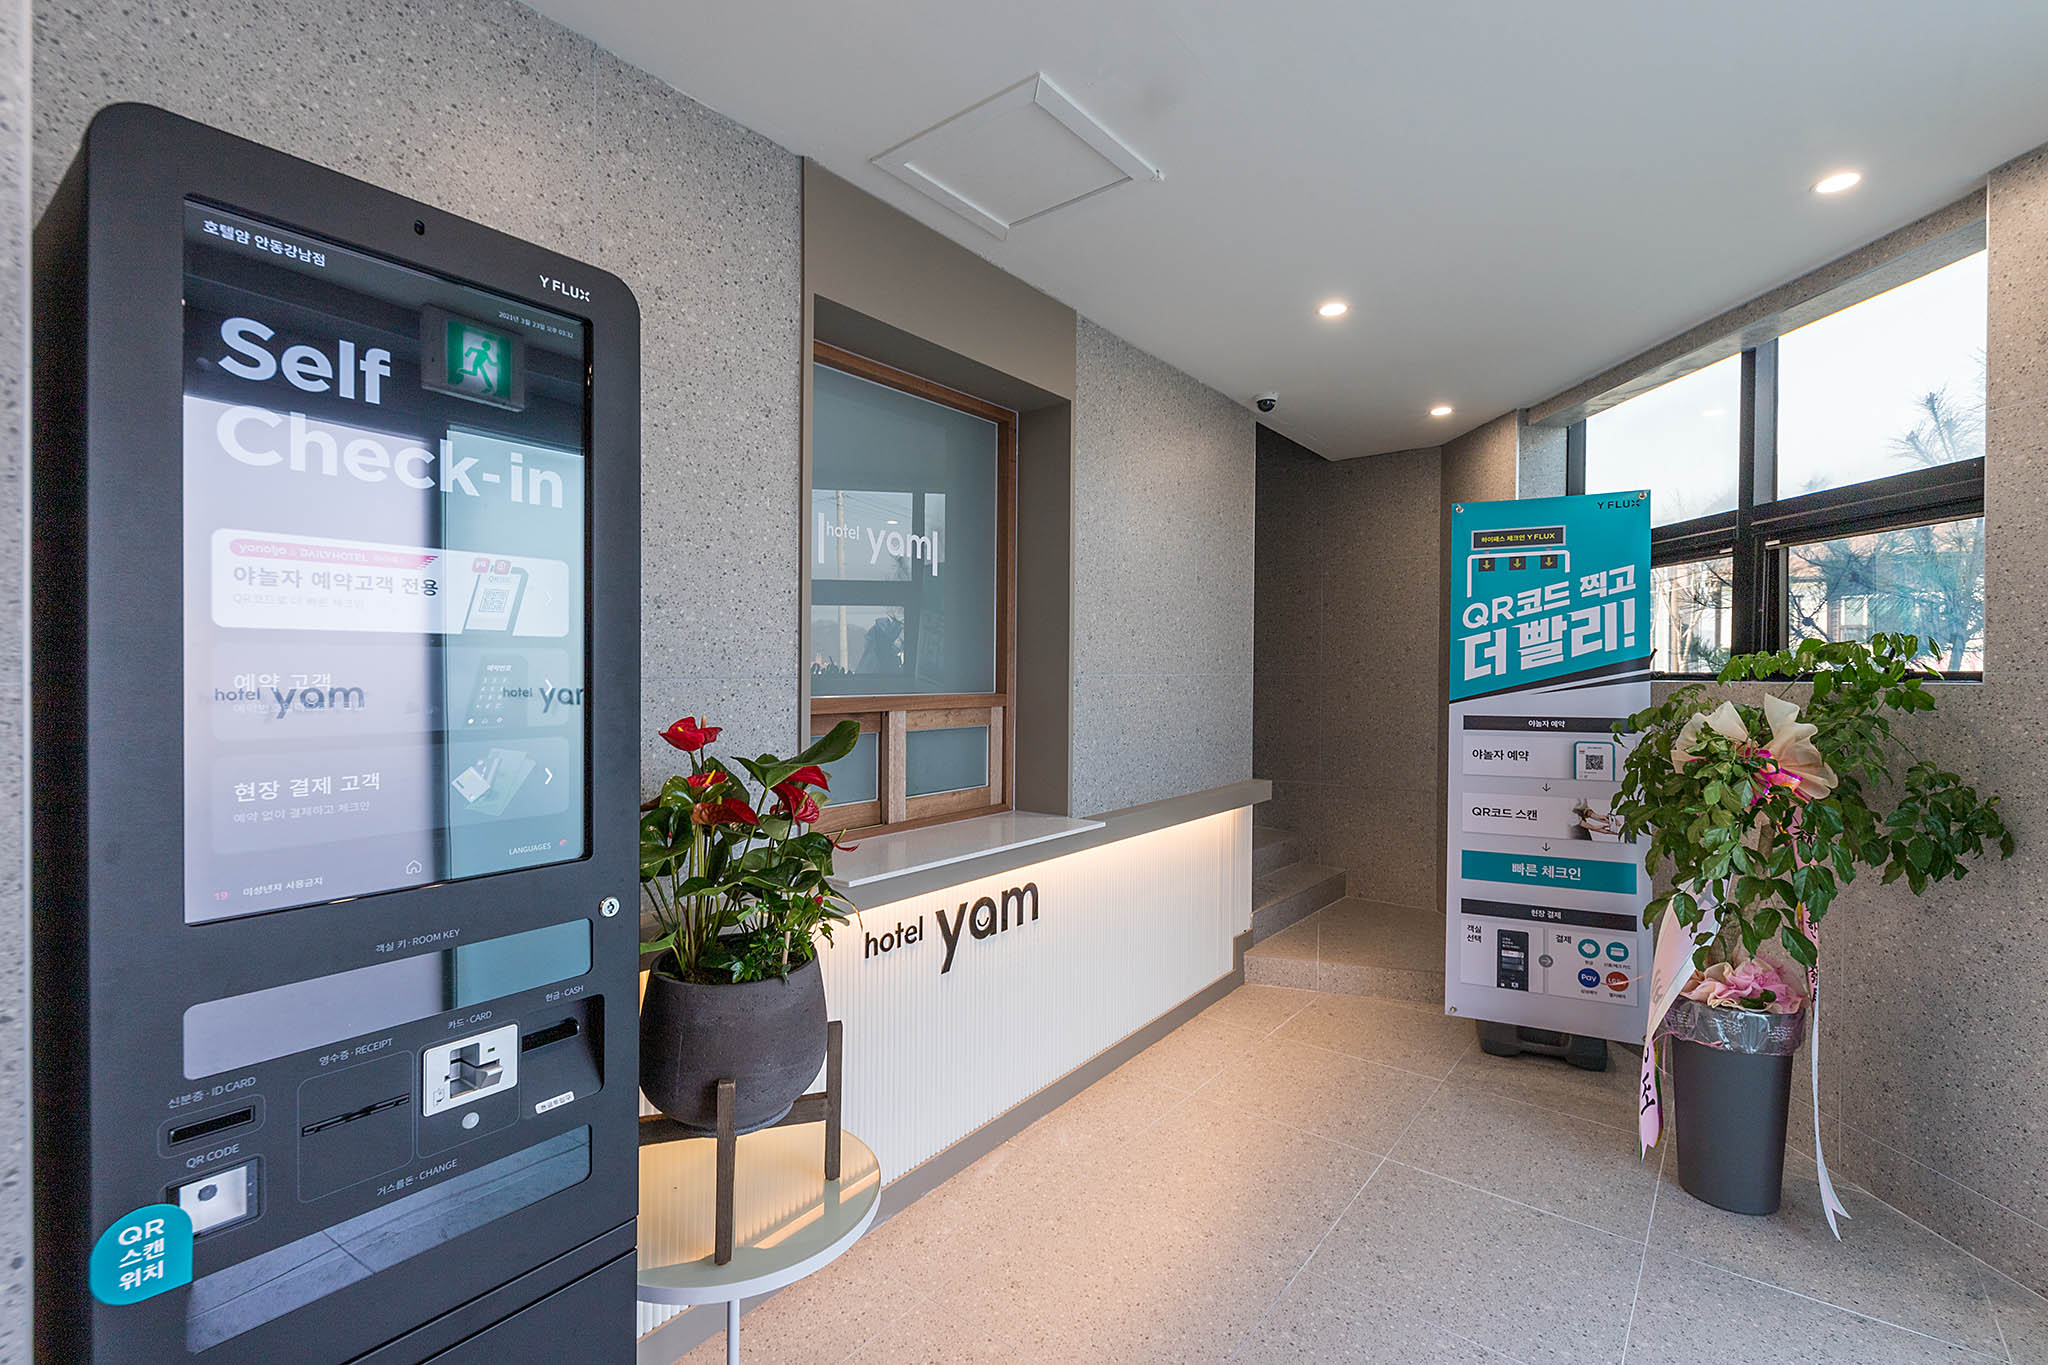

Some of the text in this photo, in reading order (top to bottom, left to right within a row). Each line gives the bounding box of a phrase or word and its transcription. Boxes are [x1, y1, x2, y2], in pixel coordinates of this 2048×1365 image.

[203, 220, 326, 267] 호텔얌 안동강남점
[540, 274, 590, 302] Y FLUX
[218, 316, 391, 405] Self
[215, 404, 564, 508] Check-in
[1607, 500, 1640, 508] FLUX
[826, 521, 932, 564] hotel yam
[233, 566, 439, 597] 야놀자 예약고객 전용
[1462, 564, 1637, 629] QR코드 찍고
[1457, 598, 1636, 681] 더 빨리!
[233, 672, 332, 691] 예약 고객
[214, 688, 261, 702] hotel
[270, 686, 366, 720] yam
[502, 687, 534, 698] hotel
[1550, 720, 1566, 728] 예약
[1472, 749, 1529, 762] 야놀자 예약
[233, 772, 381, 803] 현장 결제 고객
[233, 811, 258, 824] 예약
[1472, 807, 1538, 821] QR코드 스캔
[508, 842, 552, 856] LANGUAGES
[1512, 863, 1581, 881] 빠른 체크인
[213, 891, 229, 901] 19
[242, 876, 324, 897] 미성년자 사용금지
[1531, 909, 1562, 920] 현장 결제
[864, 881, 1040, 975] hotel yam
[1467, 924, 1482, 933] 객실
[1467, 933, 1482, 943] 선택
[375, 942, 395, 953] 객실
[412, 933, 442, 946] ROOM
[443, 928, 462, 940] KEY
[1556, 934, 1572, 944] 결제
[1581, 973, 1597, 984] Pay
[545, 985, 585, 1002] 현금 CASH
[448, 1010, 493, 1030] 카드 CARD
[319, 1038, 393, 1066] 영수증 RECEIPT
[168, 1076, 257, 1110] 신분증 ID CARD
[186, 1143, 241, 1169] QR CODE
[419, 1159, 458, 1180] CHANGE
[118, 1218, 166, 1246] QR
[118, 1238, 165, 1268] 스캔
[118, 1260, 164, 1292] 위치
